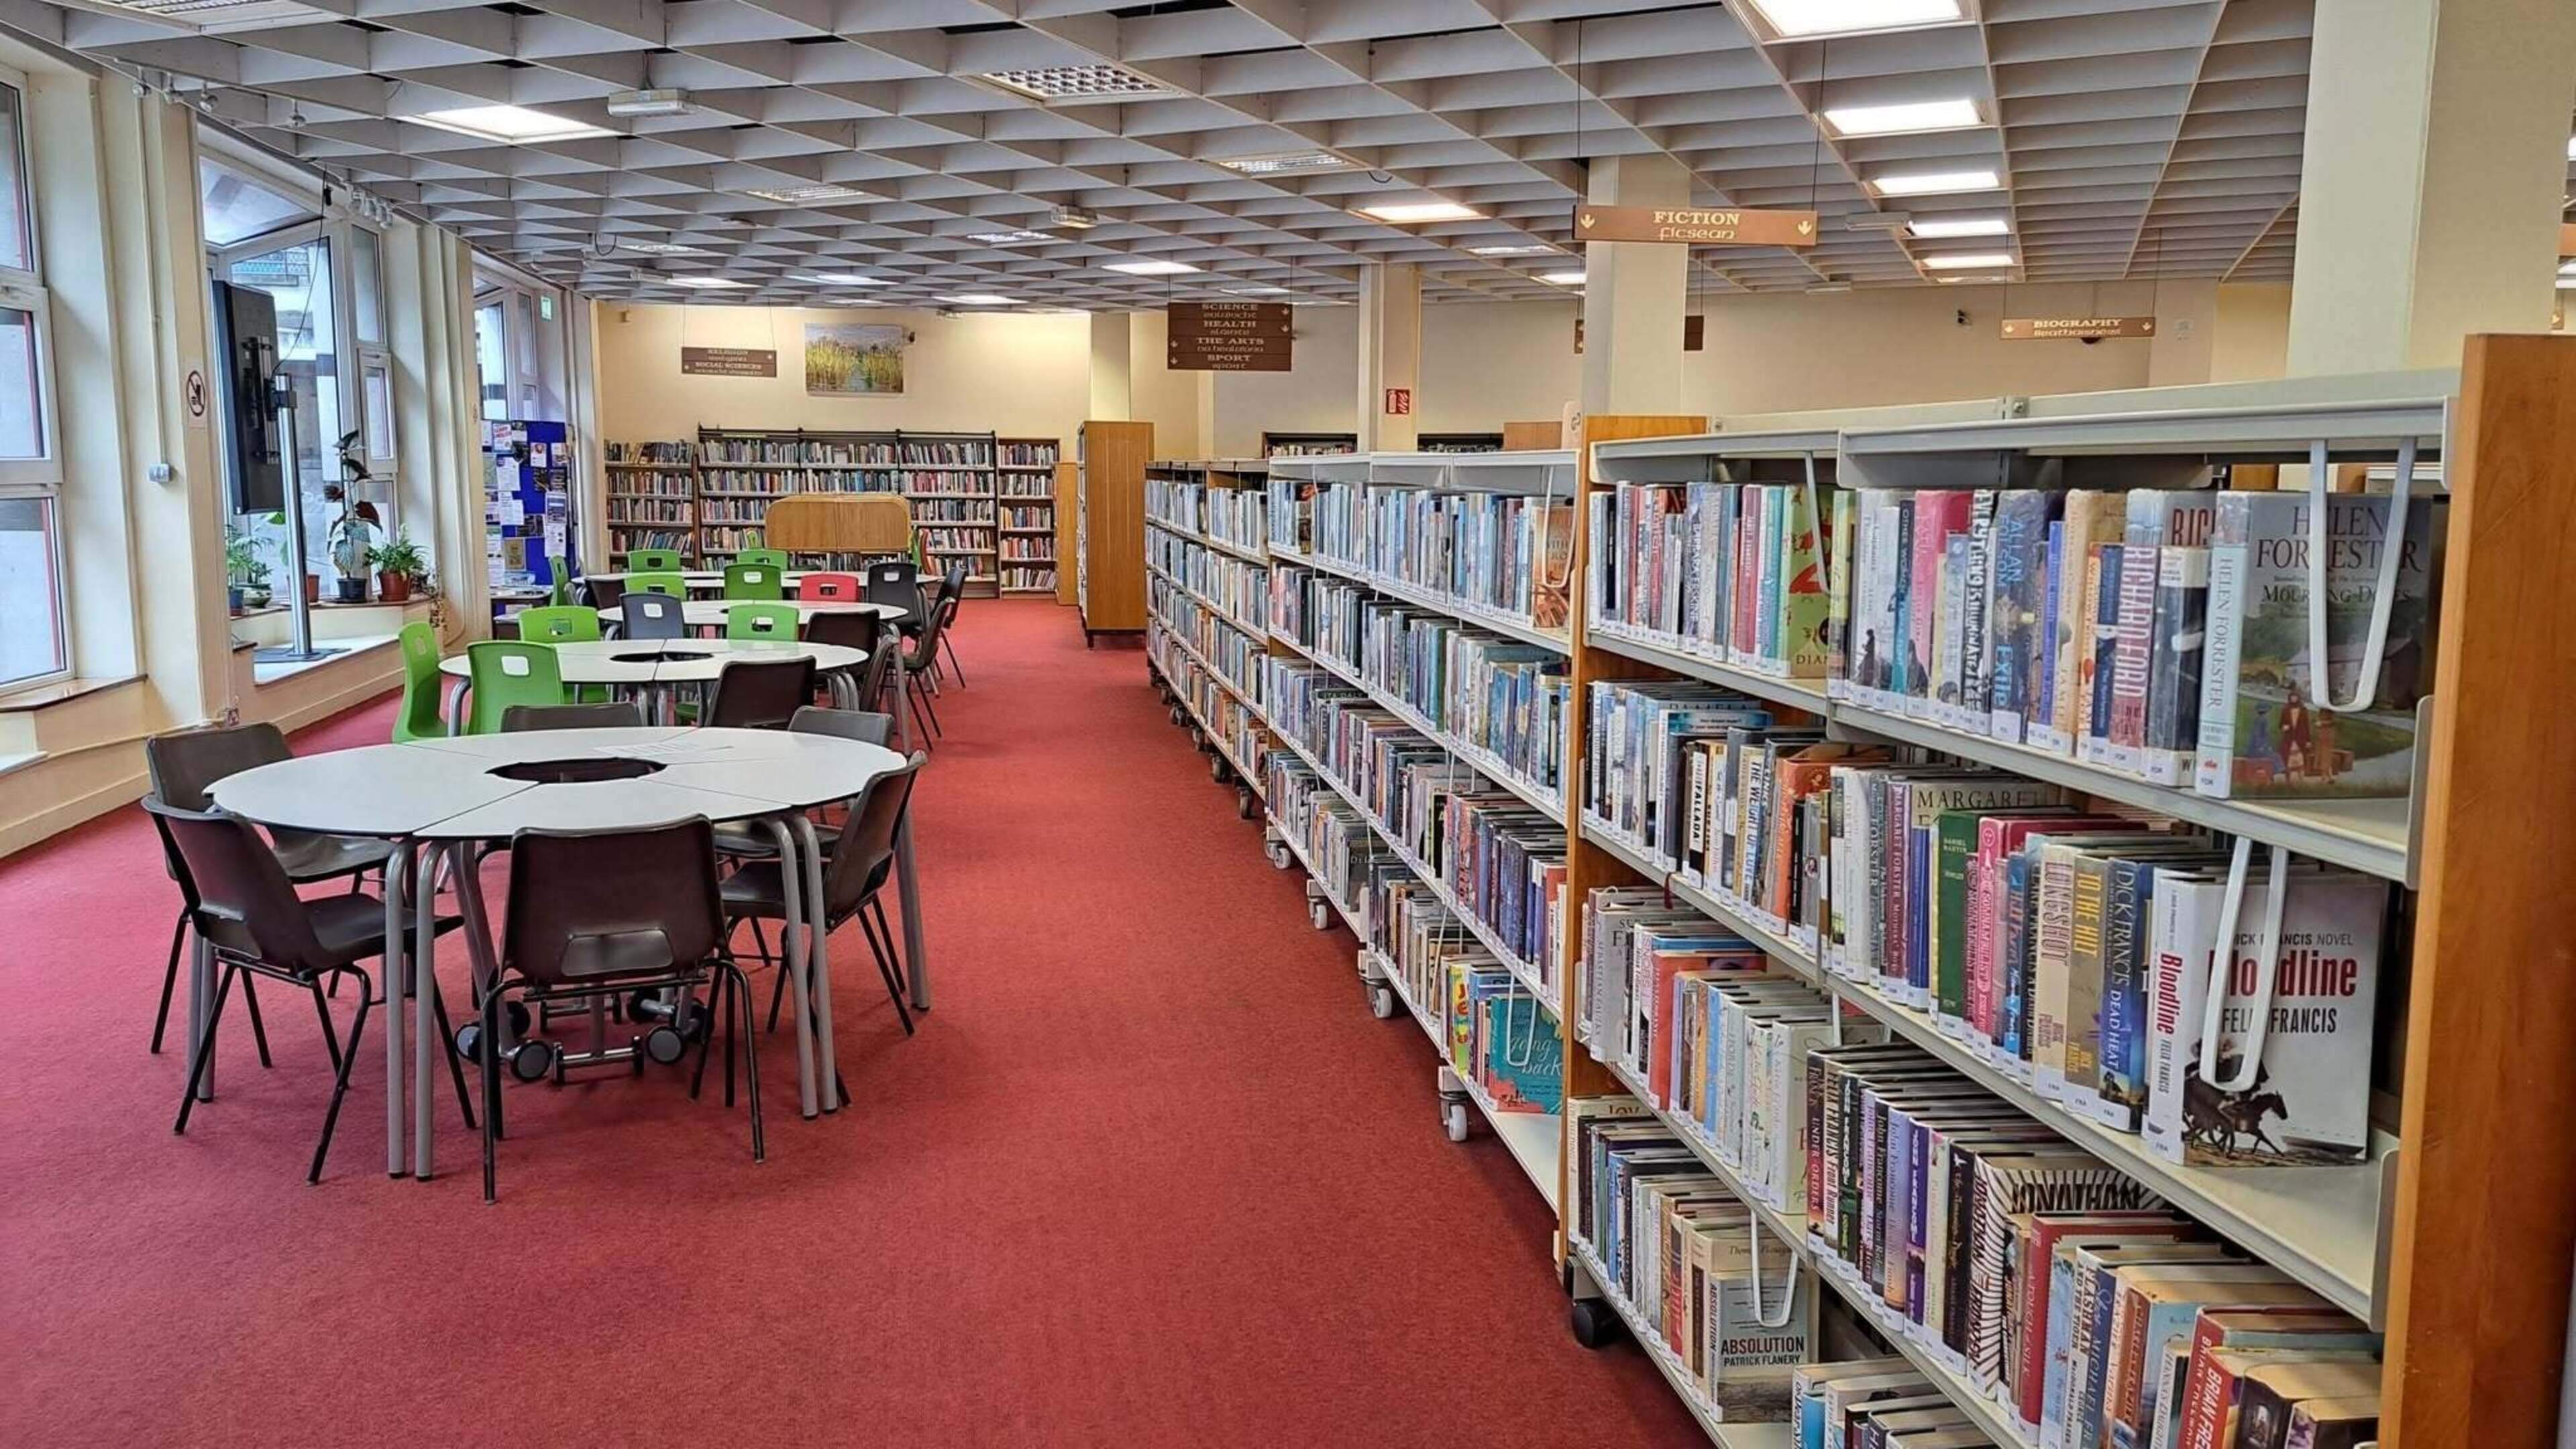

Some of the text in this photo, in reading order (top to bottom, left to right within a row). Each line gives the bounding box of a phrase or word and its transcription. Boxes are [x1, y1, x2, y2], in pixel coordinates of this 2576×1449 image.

[1652, 210, 1741, 226] FICTION
[2033, 319, 2123, 328] BIOGRAPHY
[1968, 492, 1992, 586] EVERYTHING
[2293, 506, 2387, 535] HLEN
[1997, 515, 2008, 587] FOLSOM
[2011, 518, 2023, 583] ALLAN
[2256, 538, 2422, 572] FORESTR
[2121, 547, 2156, 639] RICHARD
[2217, 557, 2234, 612] HELEN
[2114, 643, 2151, 698] FORD
[2207, 616, 2231, 708] FORRESTER
[1751, 762, 1760, 782] THE
[1693, 785, 1701, 839] FALLADA
[1748, 787, 1759, 830] WEIGHT
[1892, 791, 1902, 848] MARGARET
[1744, 853, 1754, 881] LOVE
[1892, 851, 1901, 898] FORSTER
[1979, 891, 1991, 979] SOMNAMBULIST
[2041, 862, 2072, 966] LONGSHOT
[2074, 871, 2102, 958] TO THE HILT
[2111, 870, 2135, 986] DICK FRANCIS
[2027, 913, 2039, 973] FRANCIS
[2229, 933, 2354, 946] ICK ANCIS NOVEL
[2208, 949, 2358, 997] lodline
[2039, 1013, 2053, 1048] FRANCIS
[2053, 1022, 2064, 1044] DICK
[2107, 989, 2123, 1070] DEAD HEAT
[2157, 953, 2182, 1094] Bloodline FELIX FRANCIS
[2269, 1008, 2337, 1034] FRANCIS
[1510, 1036, 1552, 1059] gong
[2067, 1042, 2080, 1073] FRANCIS
[2080, 1051, 2093, 1070] DICK
[1827, 1073, 1839, 1103] FELIX
[1826, 1108, 1838, 1159] FRANCIS
[1877, 1115, 1886, 1144] John
[1811, 1118, 1819, 1210] UNDER ORDERS
[1876, 1146, 1885, 1203] Francome
[1888, 1155, 1898, 1213] Francome
[1826, 1191, 1837, 1224] Runner
[2012, 1183, 2146, 1210] JONATHAN
[1969, 1177, 1988, 1369] JONATHAN FRANZEN
[2025, 1285, 2035, 1332] TOUCH
[2074, 1291, 2082, 1310] THE
[2080, 1267, 2096, 1355] FLASHMAN
[1721, 1337, 1805, 1354] ABSOLUTION
[2072, 1315, 2080, 1348] TIGER
[1724, 1355, 1801, 1367] PATRICK FLANERY
[2086, 1339, 2102, 1414] MICHAEL
[2186, 1336, 2212, 1446] BRIAN FREEMAN
[2200, 1368, 2222, 1419] BRIAN
